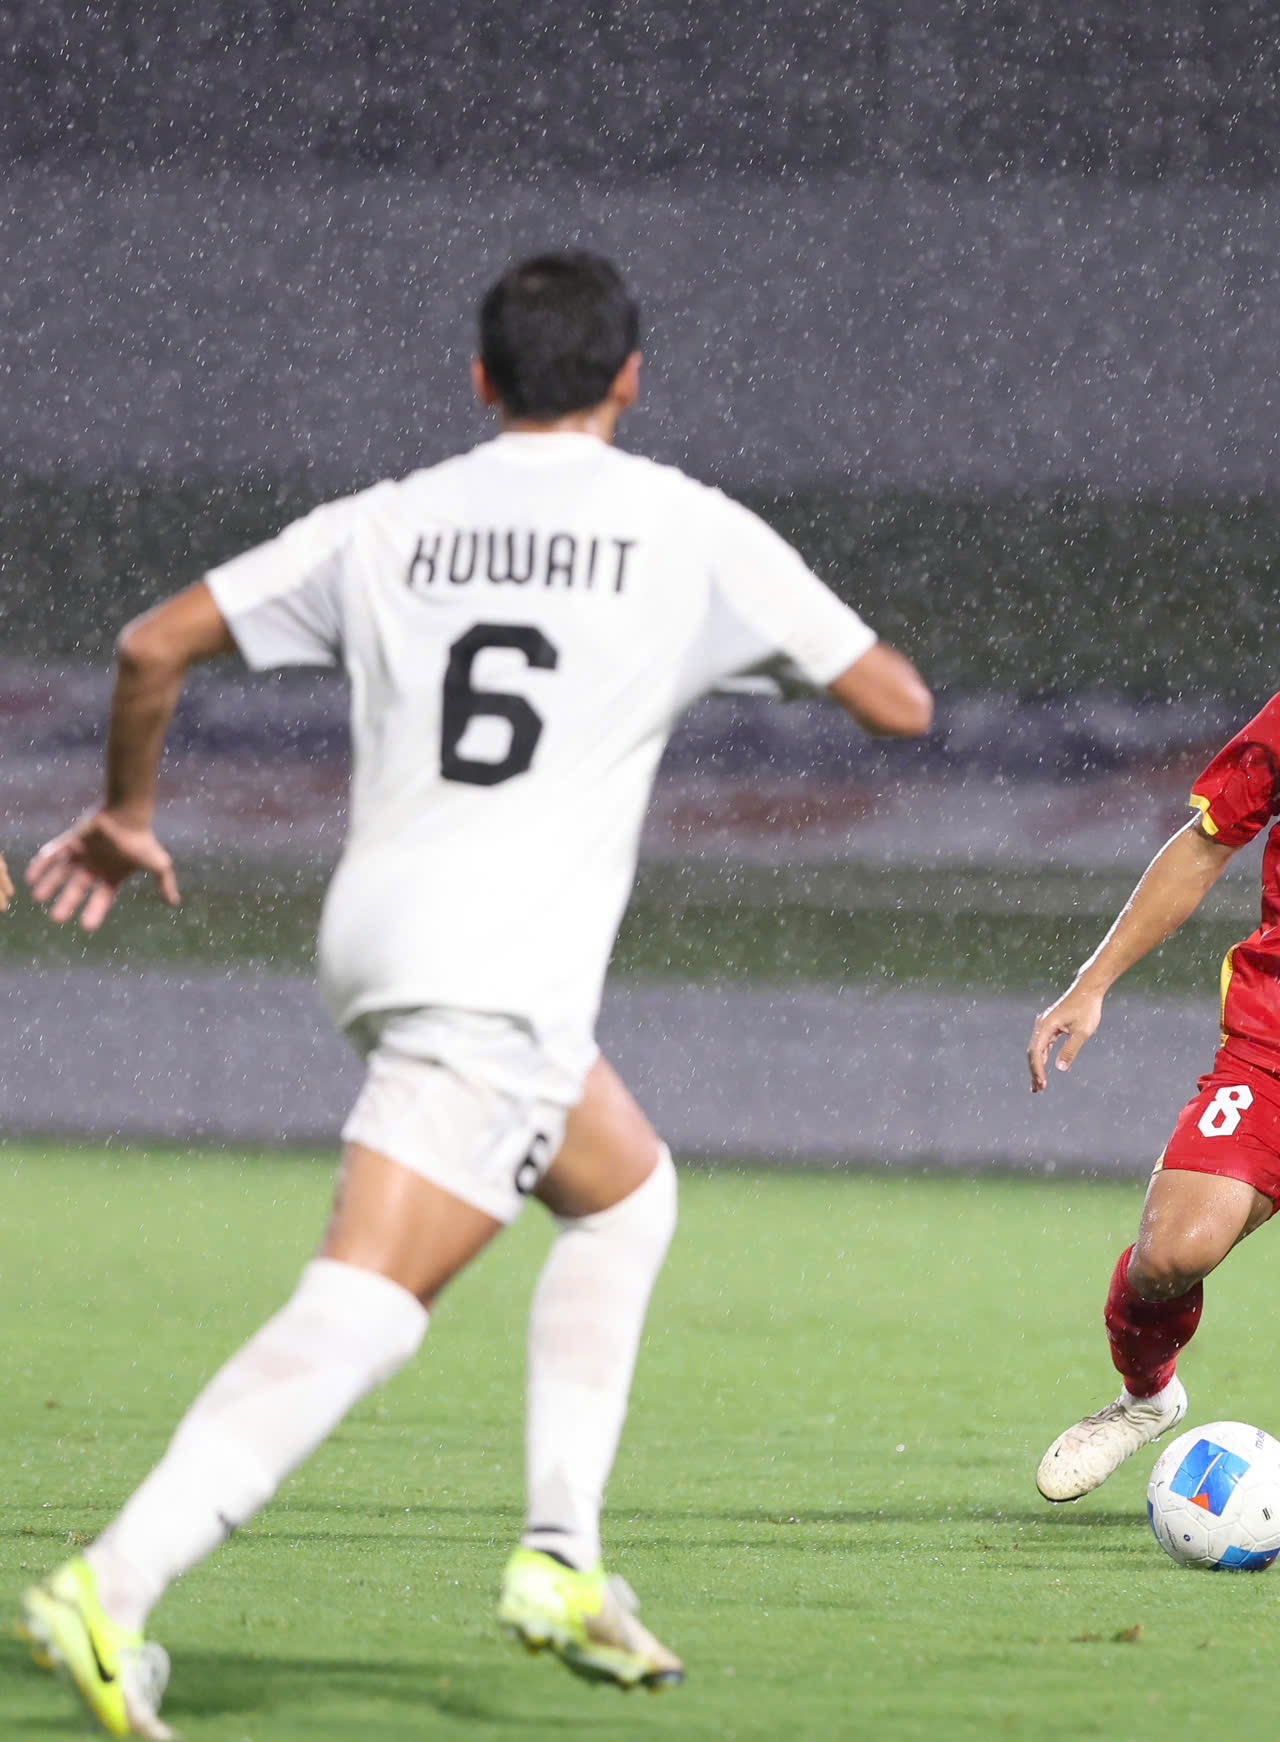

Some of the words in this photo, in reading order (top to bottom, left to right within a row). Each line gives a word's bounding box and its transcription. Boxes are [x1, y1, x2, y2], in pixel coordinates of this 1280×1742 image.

[407, 530, 637, 593] KUWAIT
[440, 623, 558, 786] 6
[1197, 1085, 1255, 1137] 8
